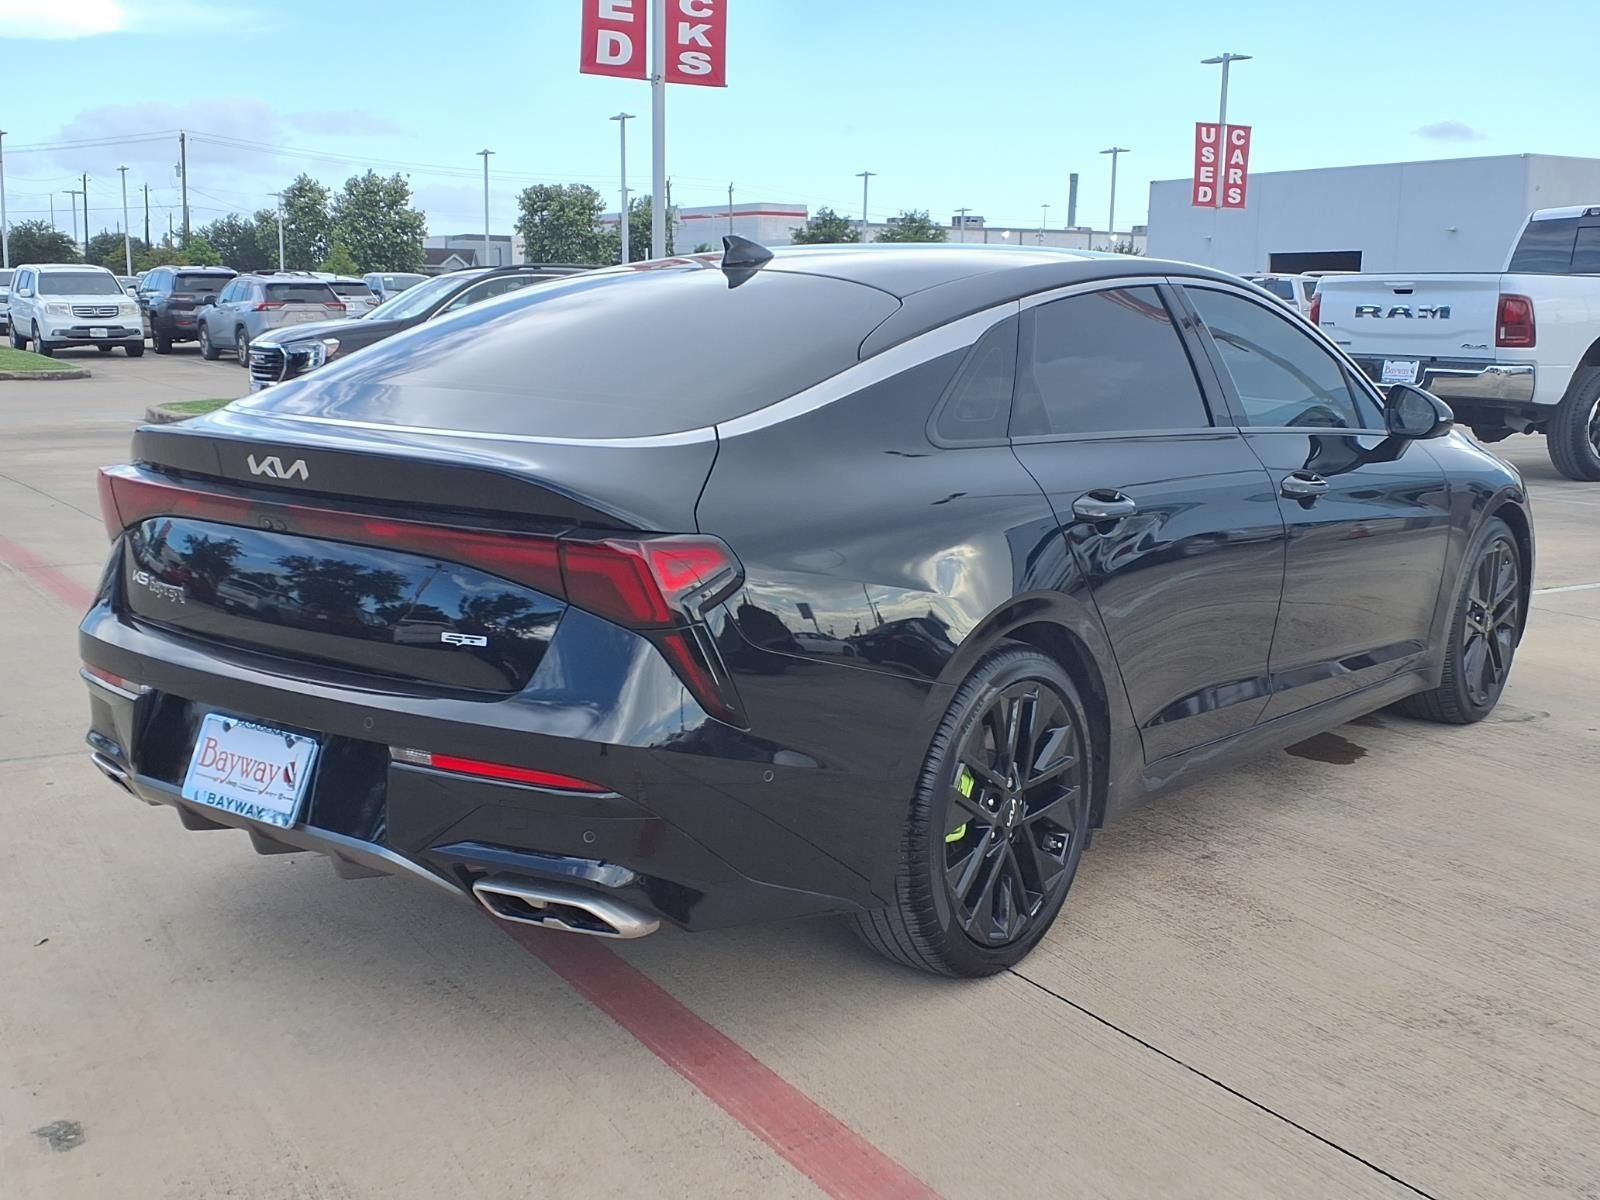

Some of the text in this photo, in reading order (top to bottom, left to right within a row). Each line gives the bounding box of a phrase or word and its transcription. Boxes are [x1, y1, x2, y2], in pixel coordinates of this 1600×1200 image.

[1197, 126, 1216, 203] USED
[1227, 129, 1246, 204] CARS
[1355, 304, 1450, 320] RAM
[247, 454, 309, 481] KIA
[198, 736, 281, 795] Bayway
